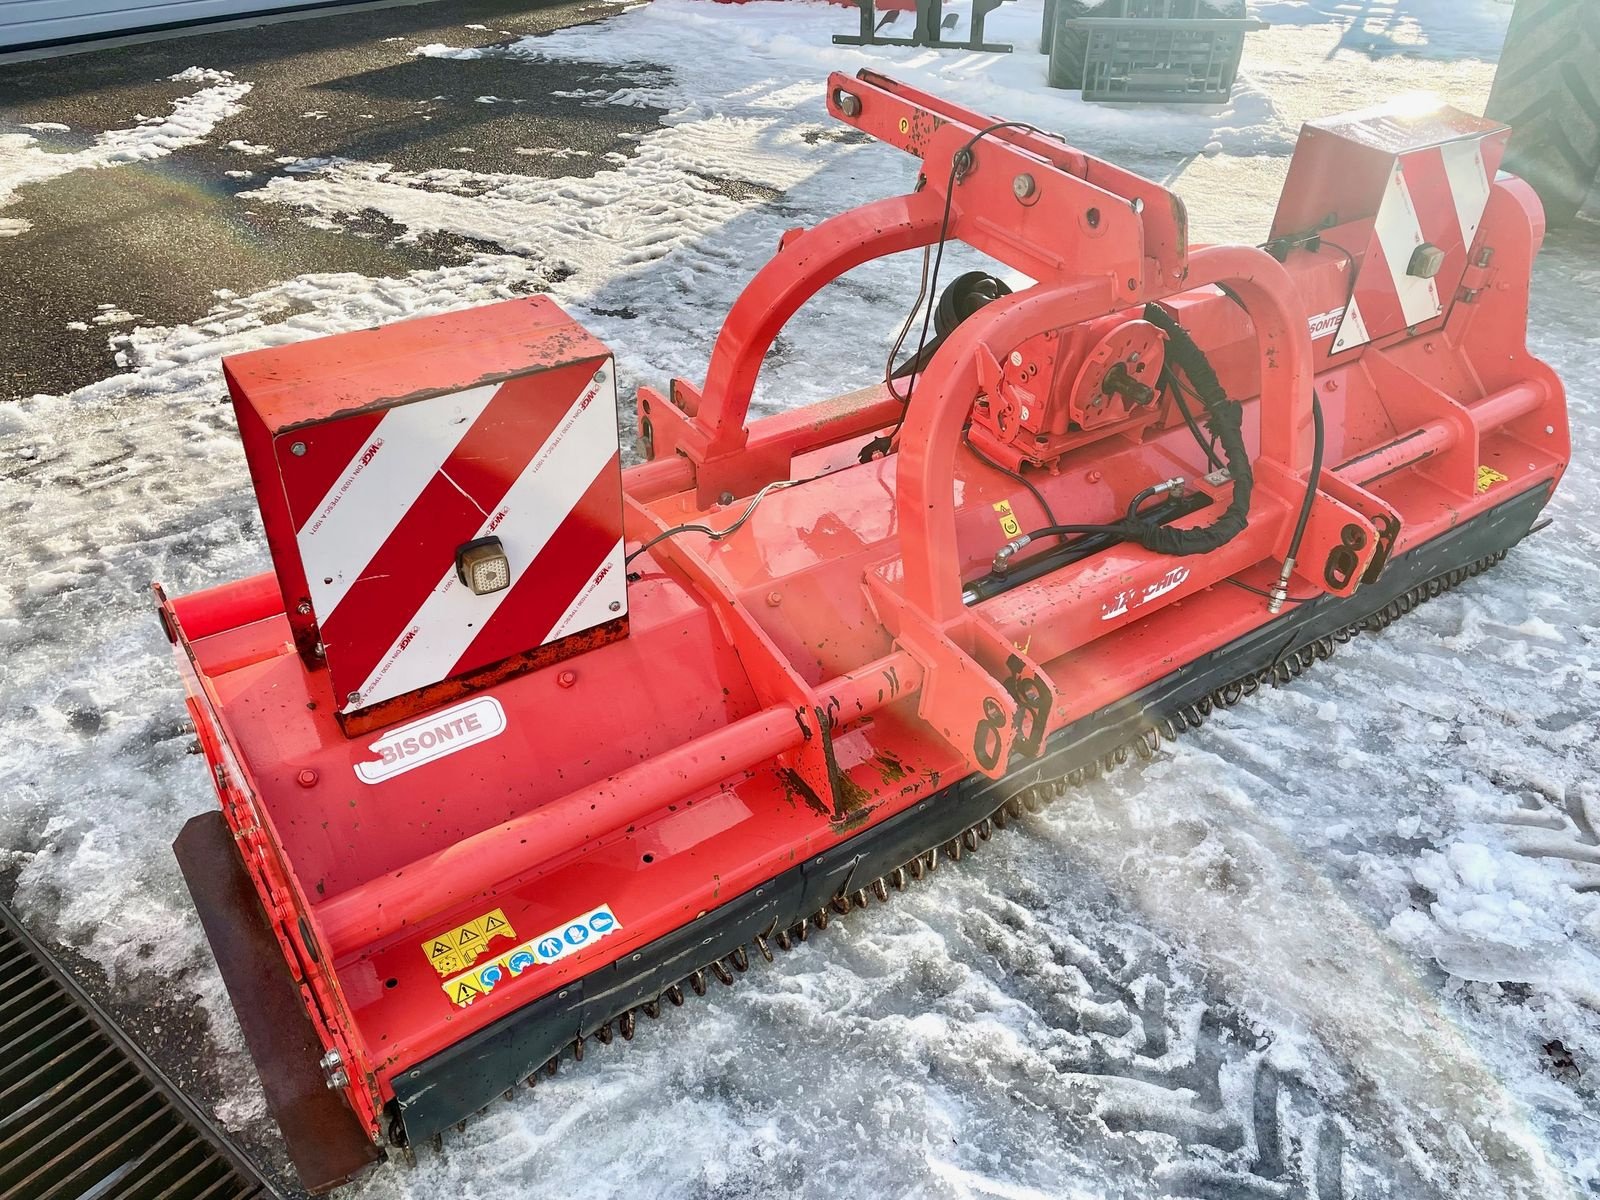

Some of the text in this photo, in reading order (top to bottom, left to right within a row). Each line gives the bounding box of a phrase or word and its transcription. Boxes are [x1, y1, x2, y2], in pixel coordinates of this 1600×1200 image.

[580, 390, 596, 411] WGF
[572, 408, 583, 419] DIN
[562, 420, 575, 434] 11030
[361, 444, 380, 467] WGF
[352, 464, 364, 476] DIN
[340, 476, 355, 492] 11030
[324, 495, 341, 514] TPESC
[308, 520, 323, 535] 10071
[489, 512, 505, 532] WGF
[595, 567, 609, 586] WGF
[587, 584, 596, 594] DIN
[400, 631, 415, 651] WGF
[391, 649, 402, 659] DIN
[381, 660, 394, 673] 11030
[365, 676, 382, 694] TPESC
[378, 713, 482, 766] BISONTE
